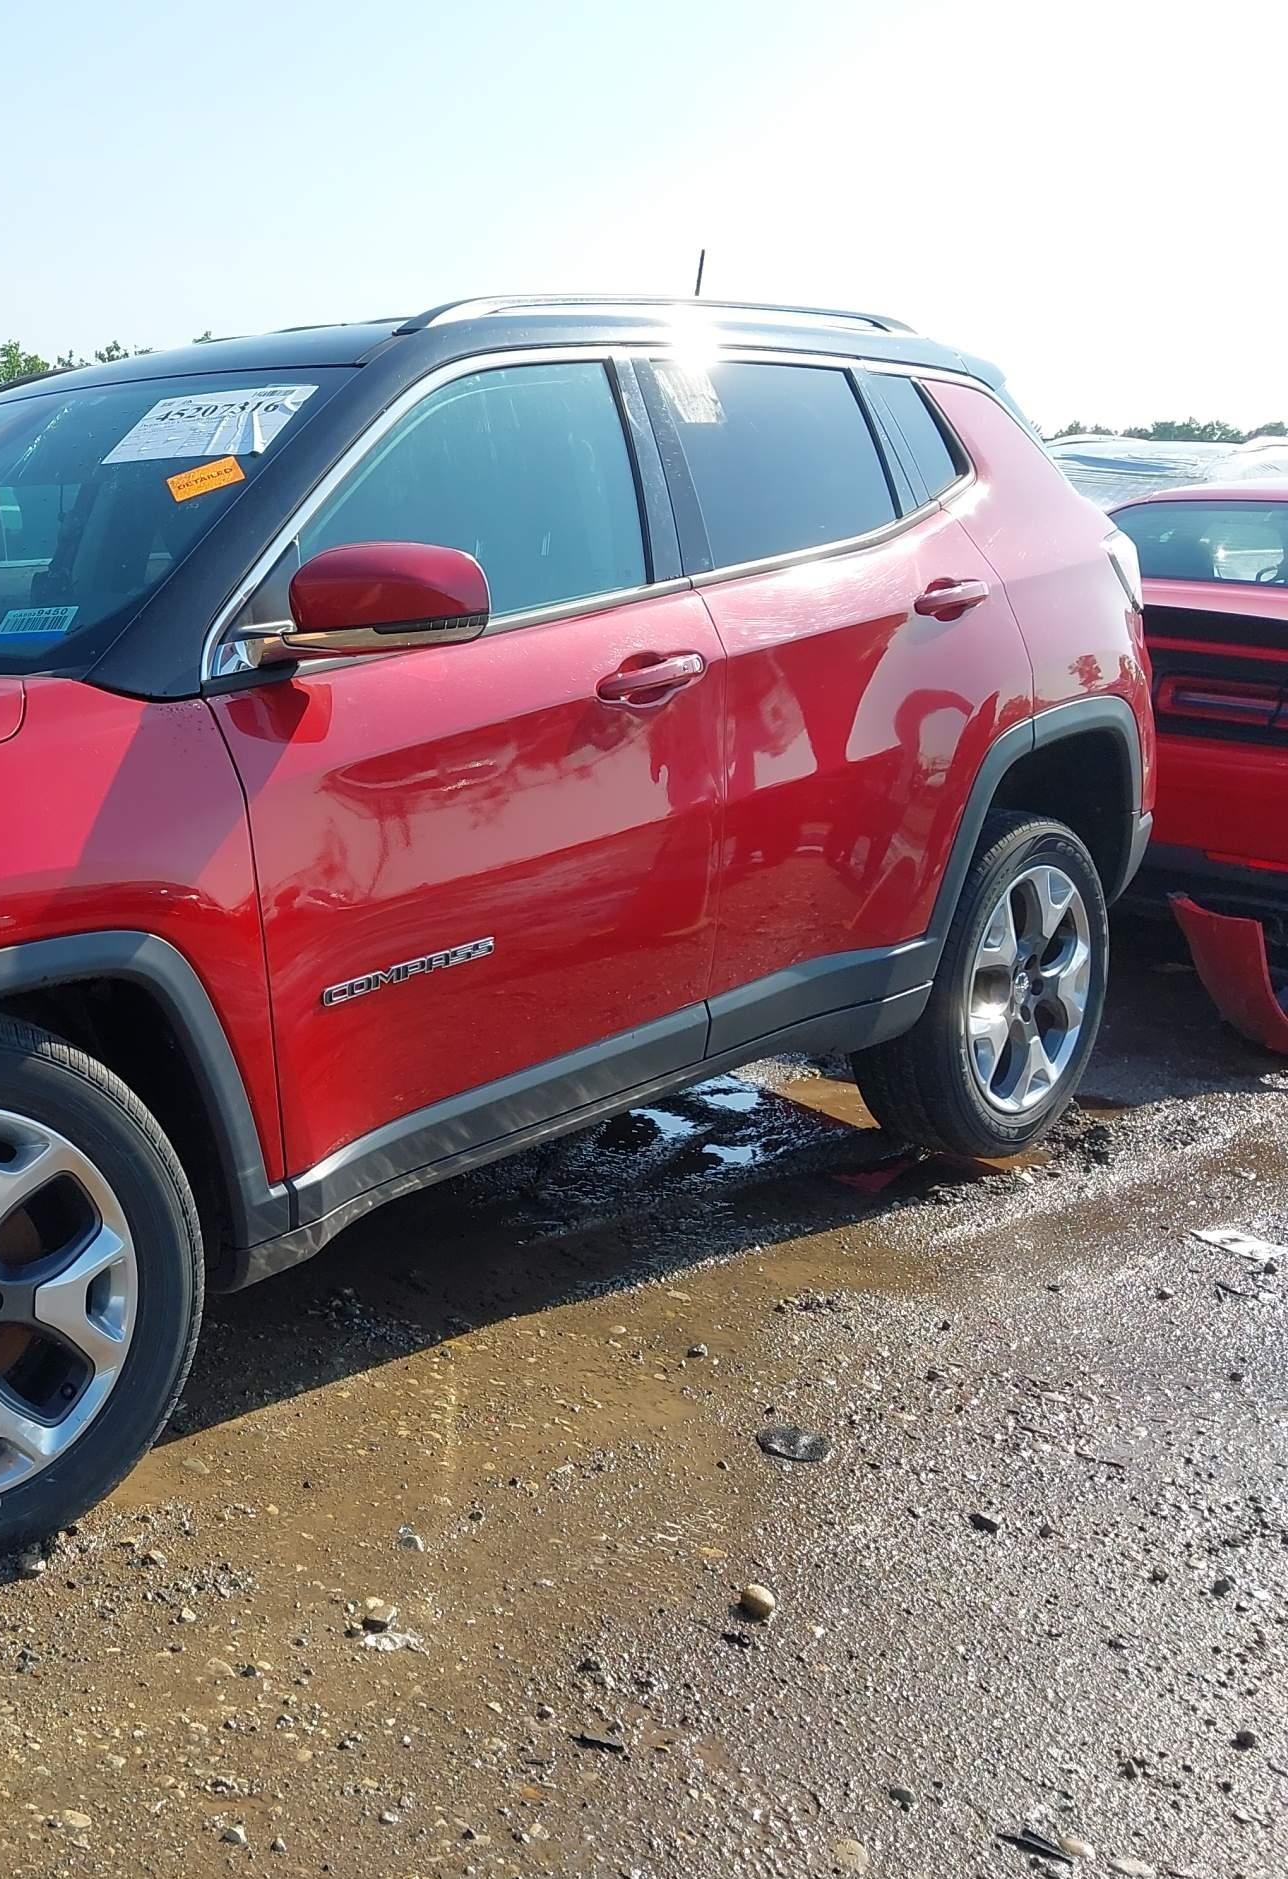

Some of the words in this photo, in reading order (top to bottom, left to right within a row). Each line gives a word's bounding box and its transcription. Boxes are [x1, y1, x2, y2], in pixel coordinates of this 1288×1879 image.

[155, 401, 279, 421] 45207316
[177, 468, 233, 490] DETAILED
[323, 936, 494, 1007] COMPASS
